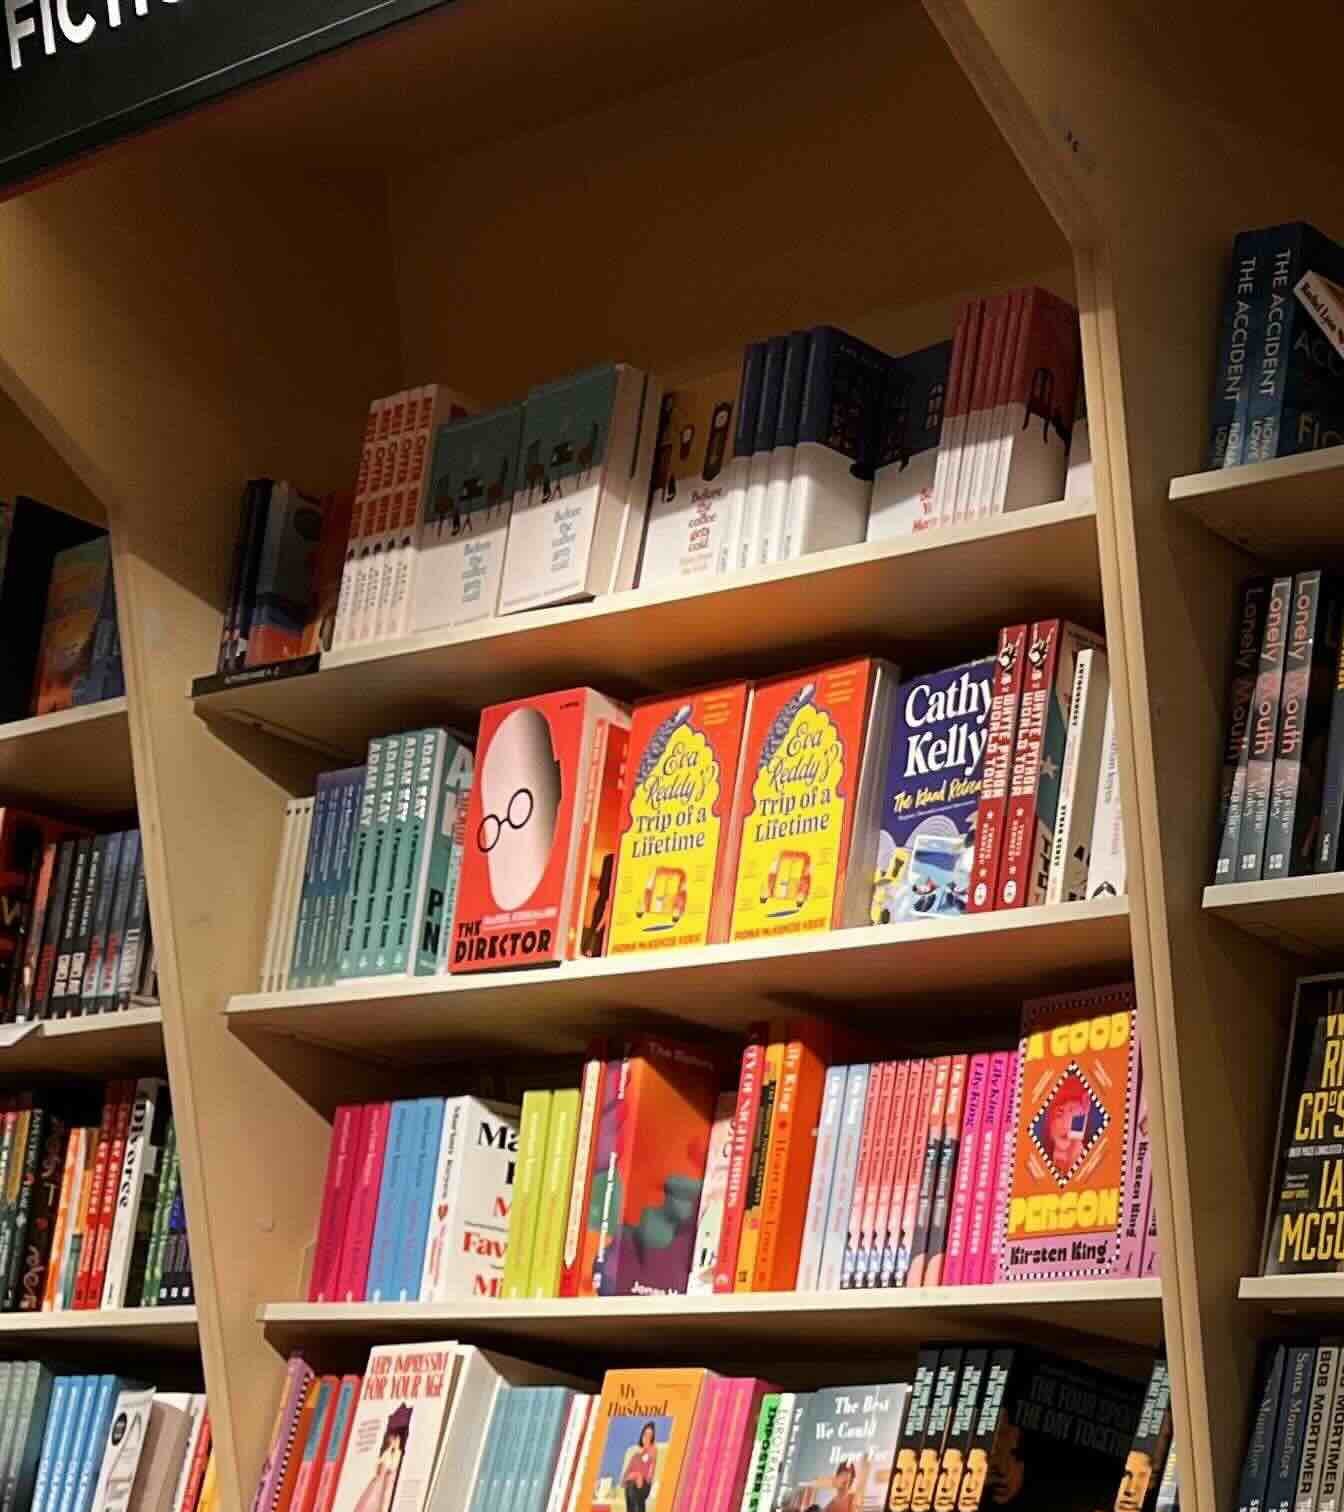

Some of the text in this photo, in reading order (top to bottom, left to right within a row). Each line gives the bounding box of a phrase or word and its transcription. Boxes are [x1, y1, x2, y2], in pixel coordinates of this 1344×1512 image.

[905, 680, 996, 727] Cathy
[904, 725, 987, 777] Kelly
[454, 927, 552, 962] DIRECTOR
[455, 920, 481, 941] THE
[1052, 1011, 1131, 1056] GOOD
[1010, 1240, 1108, 1265] Kirsten King
